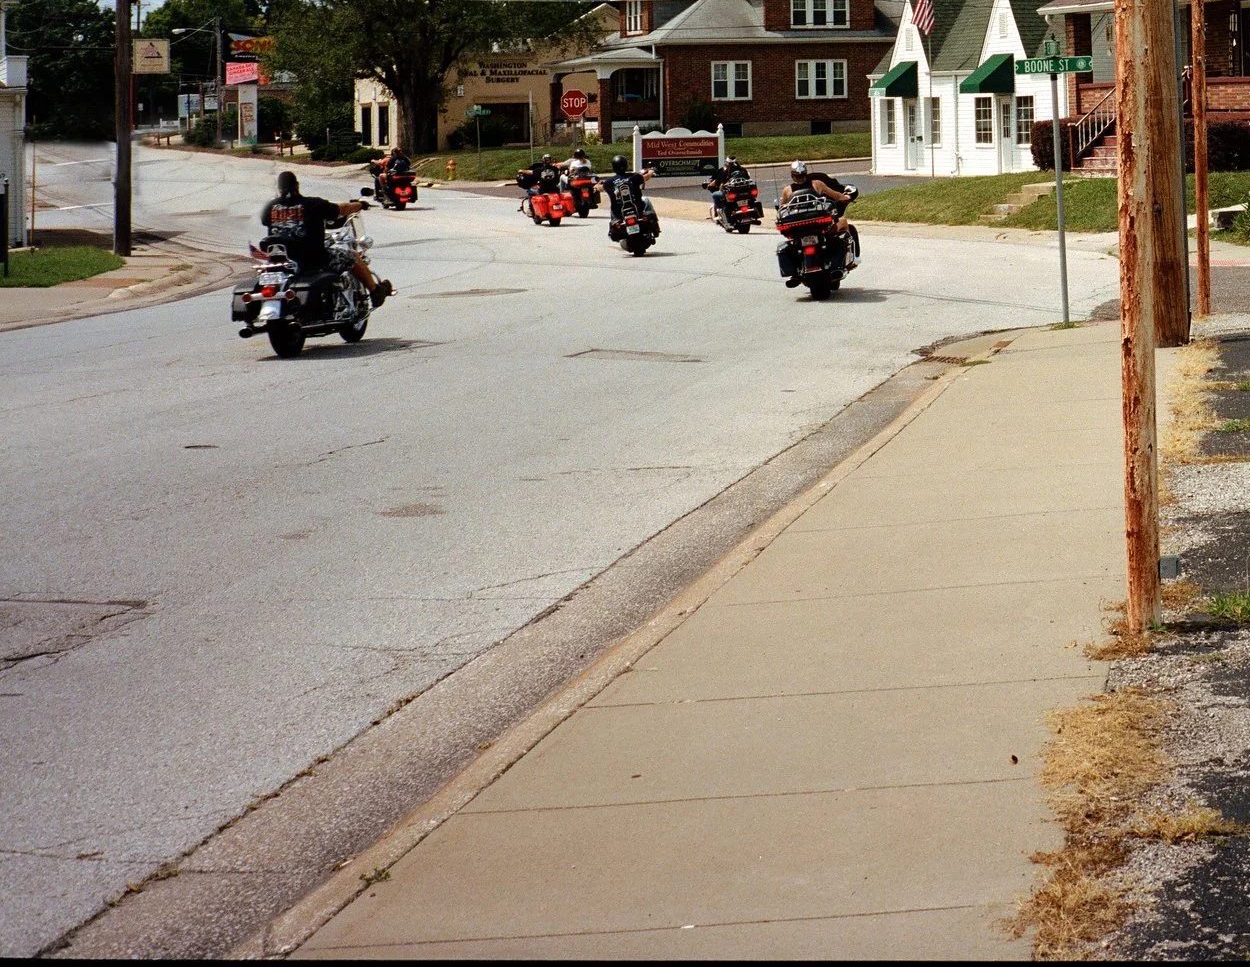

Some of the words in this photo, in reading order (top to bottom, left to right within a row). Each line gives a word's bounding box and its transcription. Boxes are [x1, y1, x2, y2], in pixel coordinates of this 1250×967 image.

[1024, 59, 1055, 73] BOONE
[1058, 59, 1070, 71] ST
[563, 97, 586, 108] STOP
